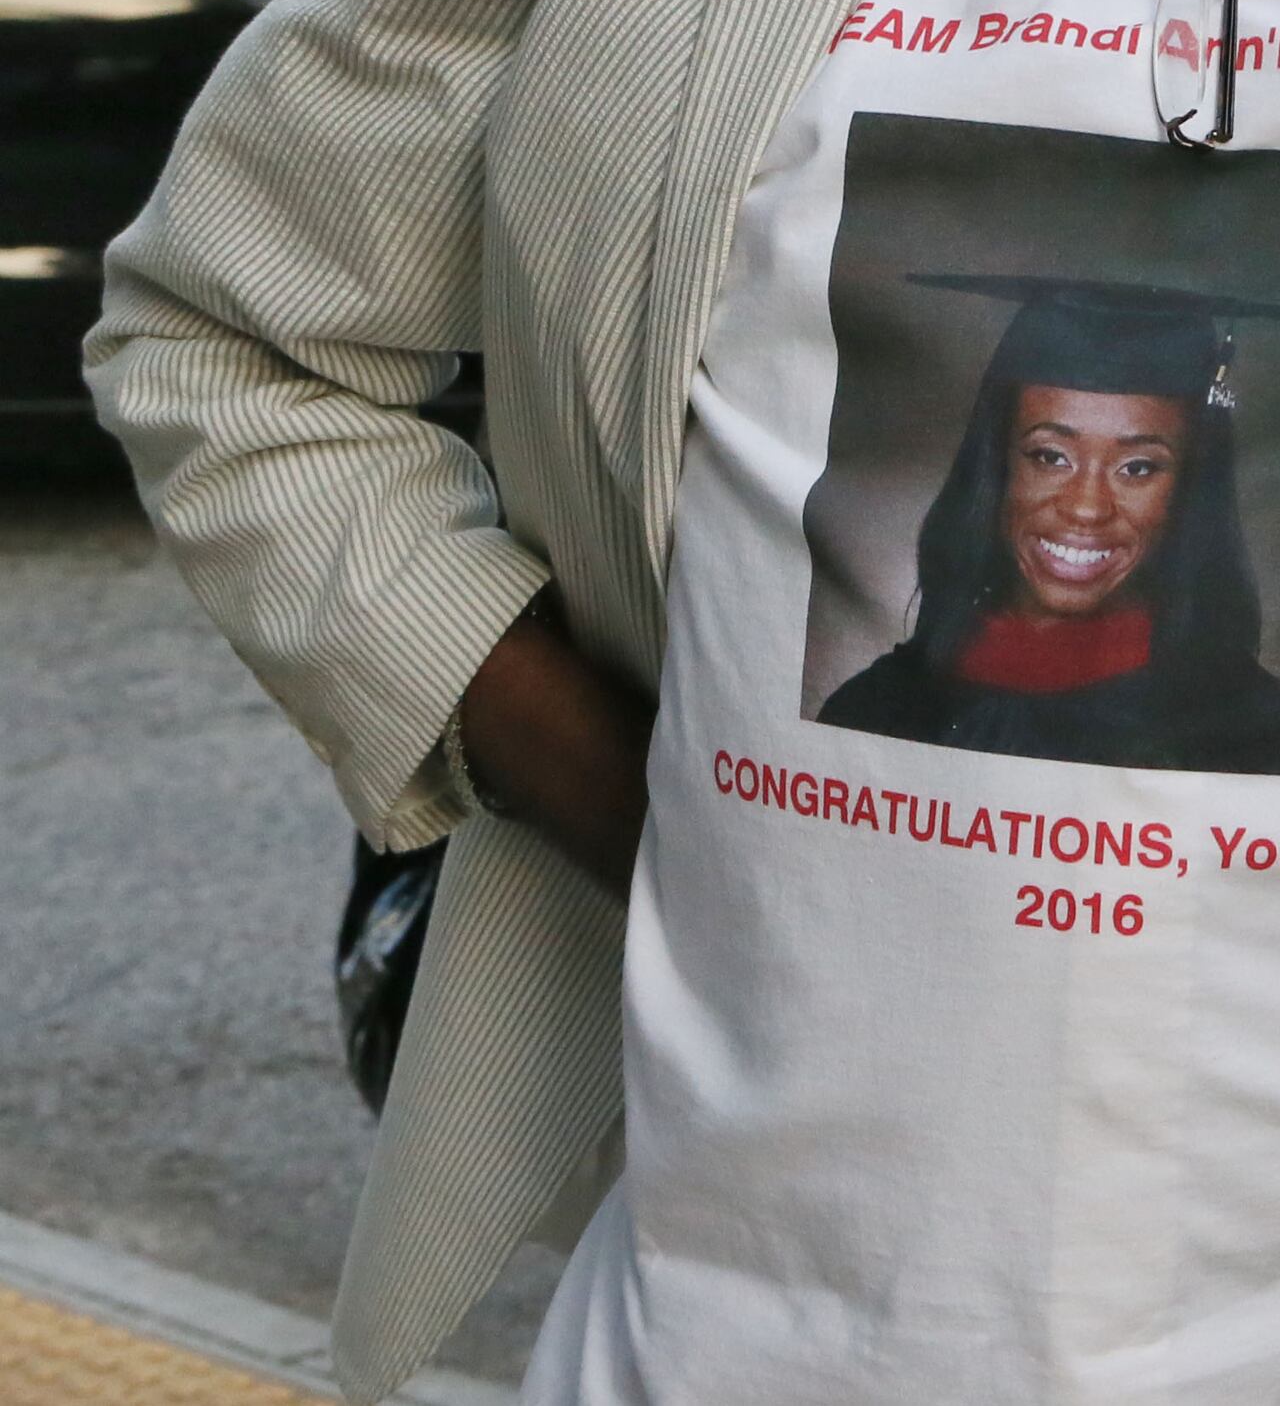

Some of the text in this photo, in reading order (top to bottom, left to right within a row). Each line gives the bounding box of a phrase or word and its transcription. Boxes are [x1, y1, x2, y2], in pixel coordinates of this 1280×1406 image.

[828, 1, 961, 55] EAM
[968, 11, 1141, 56] Brandi
[714, 749, 1189, 879] CONGRATULATIONS,
[1015, 884, 1145, 938] 2016
